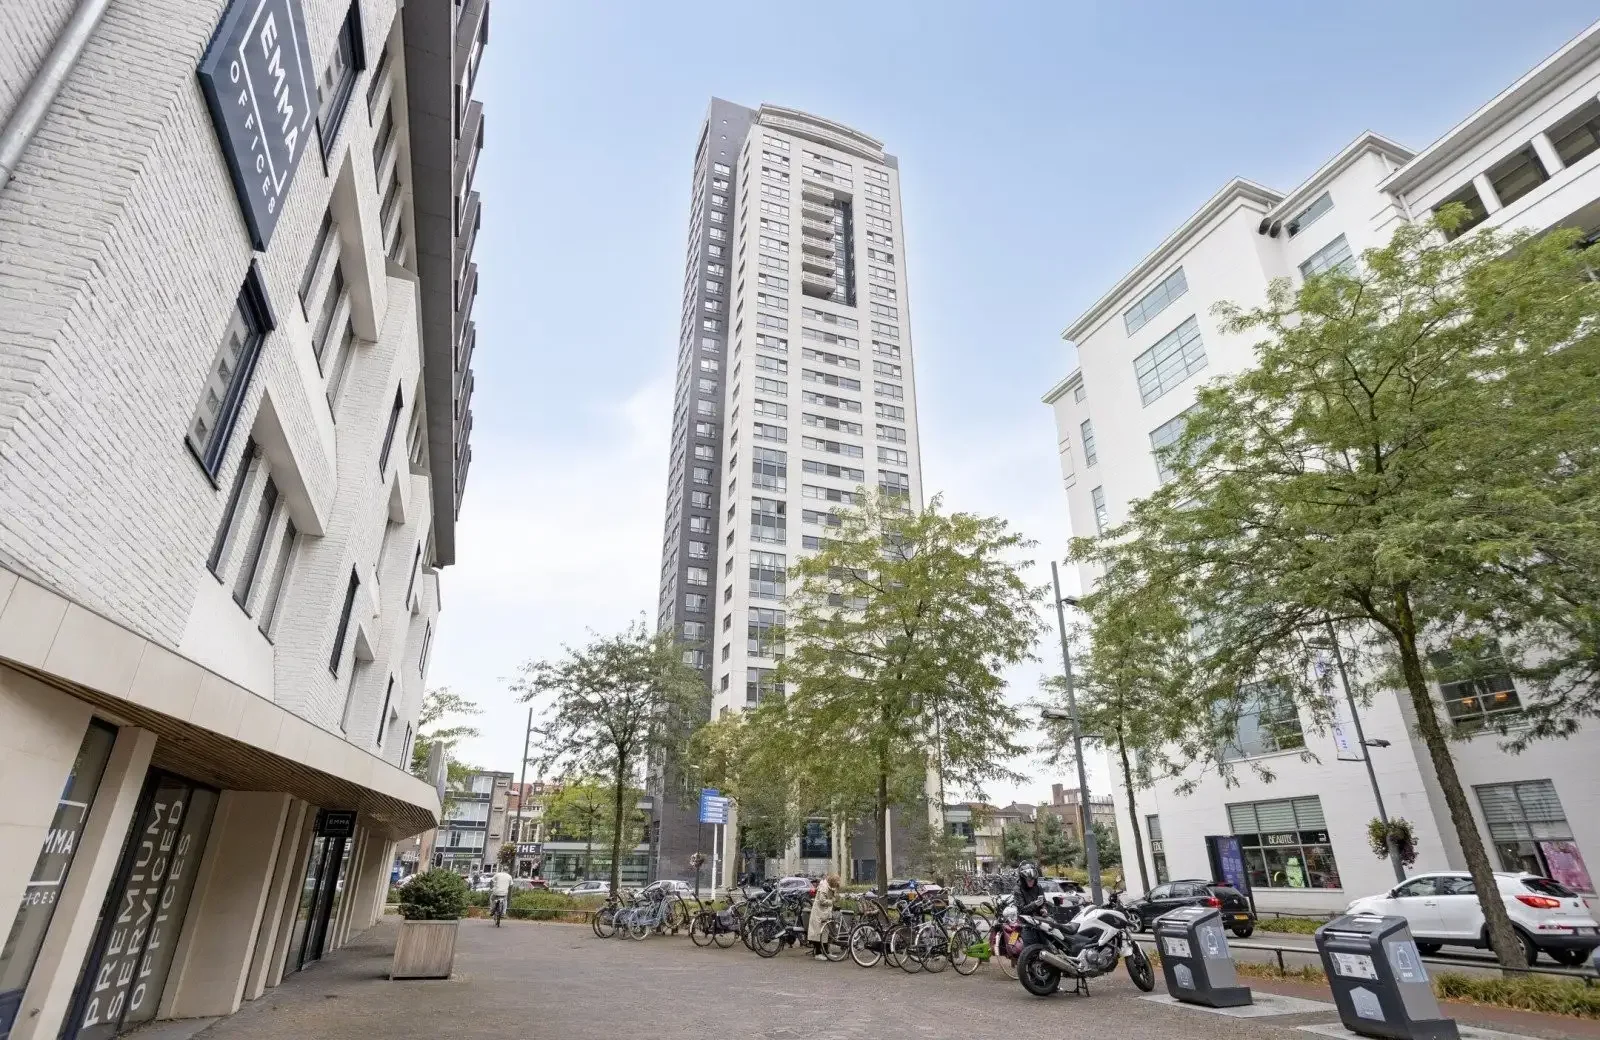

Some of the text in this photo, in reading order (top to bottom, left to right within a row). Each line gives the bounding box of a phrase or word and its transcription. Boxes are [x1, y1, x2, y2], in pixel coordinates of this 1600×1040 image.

[230, 60, 276, 215] OFFICES
[260, 11, 298, 164] EMMA
[44, 829, 76, 854] MMA
[82, 802, 167, 1029] PREMIUM
[107, 800, 183, 1020] SERVICED
[516, 845, 536, 853] THE
[130, 833, 191, 1011] OFFICES
